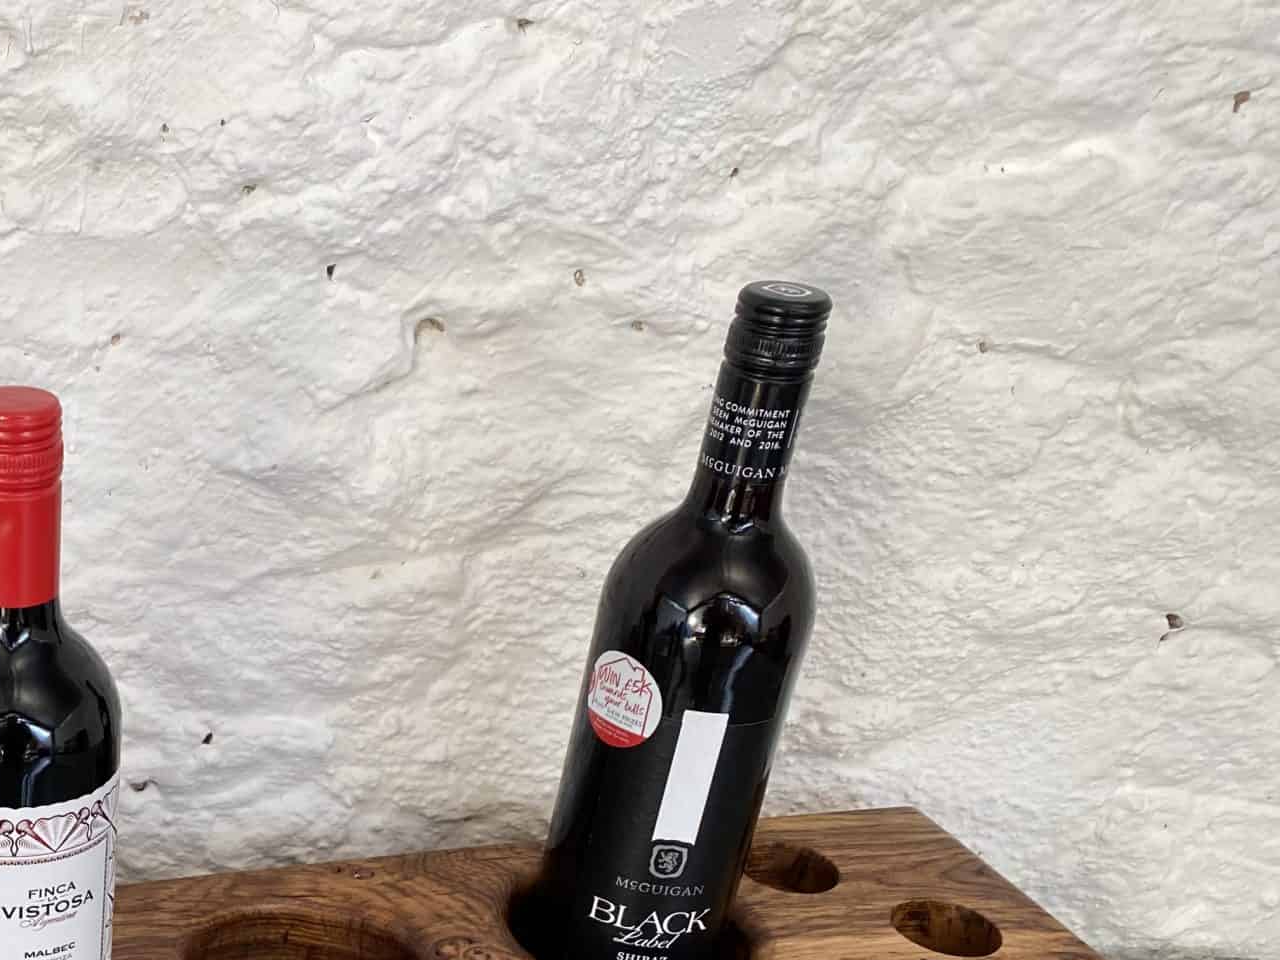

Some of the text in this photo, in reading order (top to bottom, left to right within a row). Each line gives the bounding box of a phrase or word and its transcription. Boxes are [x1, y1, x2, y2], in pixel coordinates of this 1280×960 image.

[725, 401, 791, 419] COMMITMENT
[734, 416, 788, 429] McGUIGAN
[729, 436, 752, 449] AND
[747, 429, 762, 440] OF
[767, 430, 785, 440] THE
[28, 881, 77, 900] FINCA
[615, 876, 705, 897] McGUIGAN
[1, 889, 94, 920] VISTOSA
[588, 895, 711, 935] BLACK
[612, 930, 681, 950] Label
[24, 941, 76, 960] MALBEC
